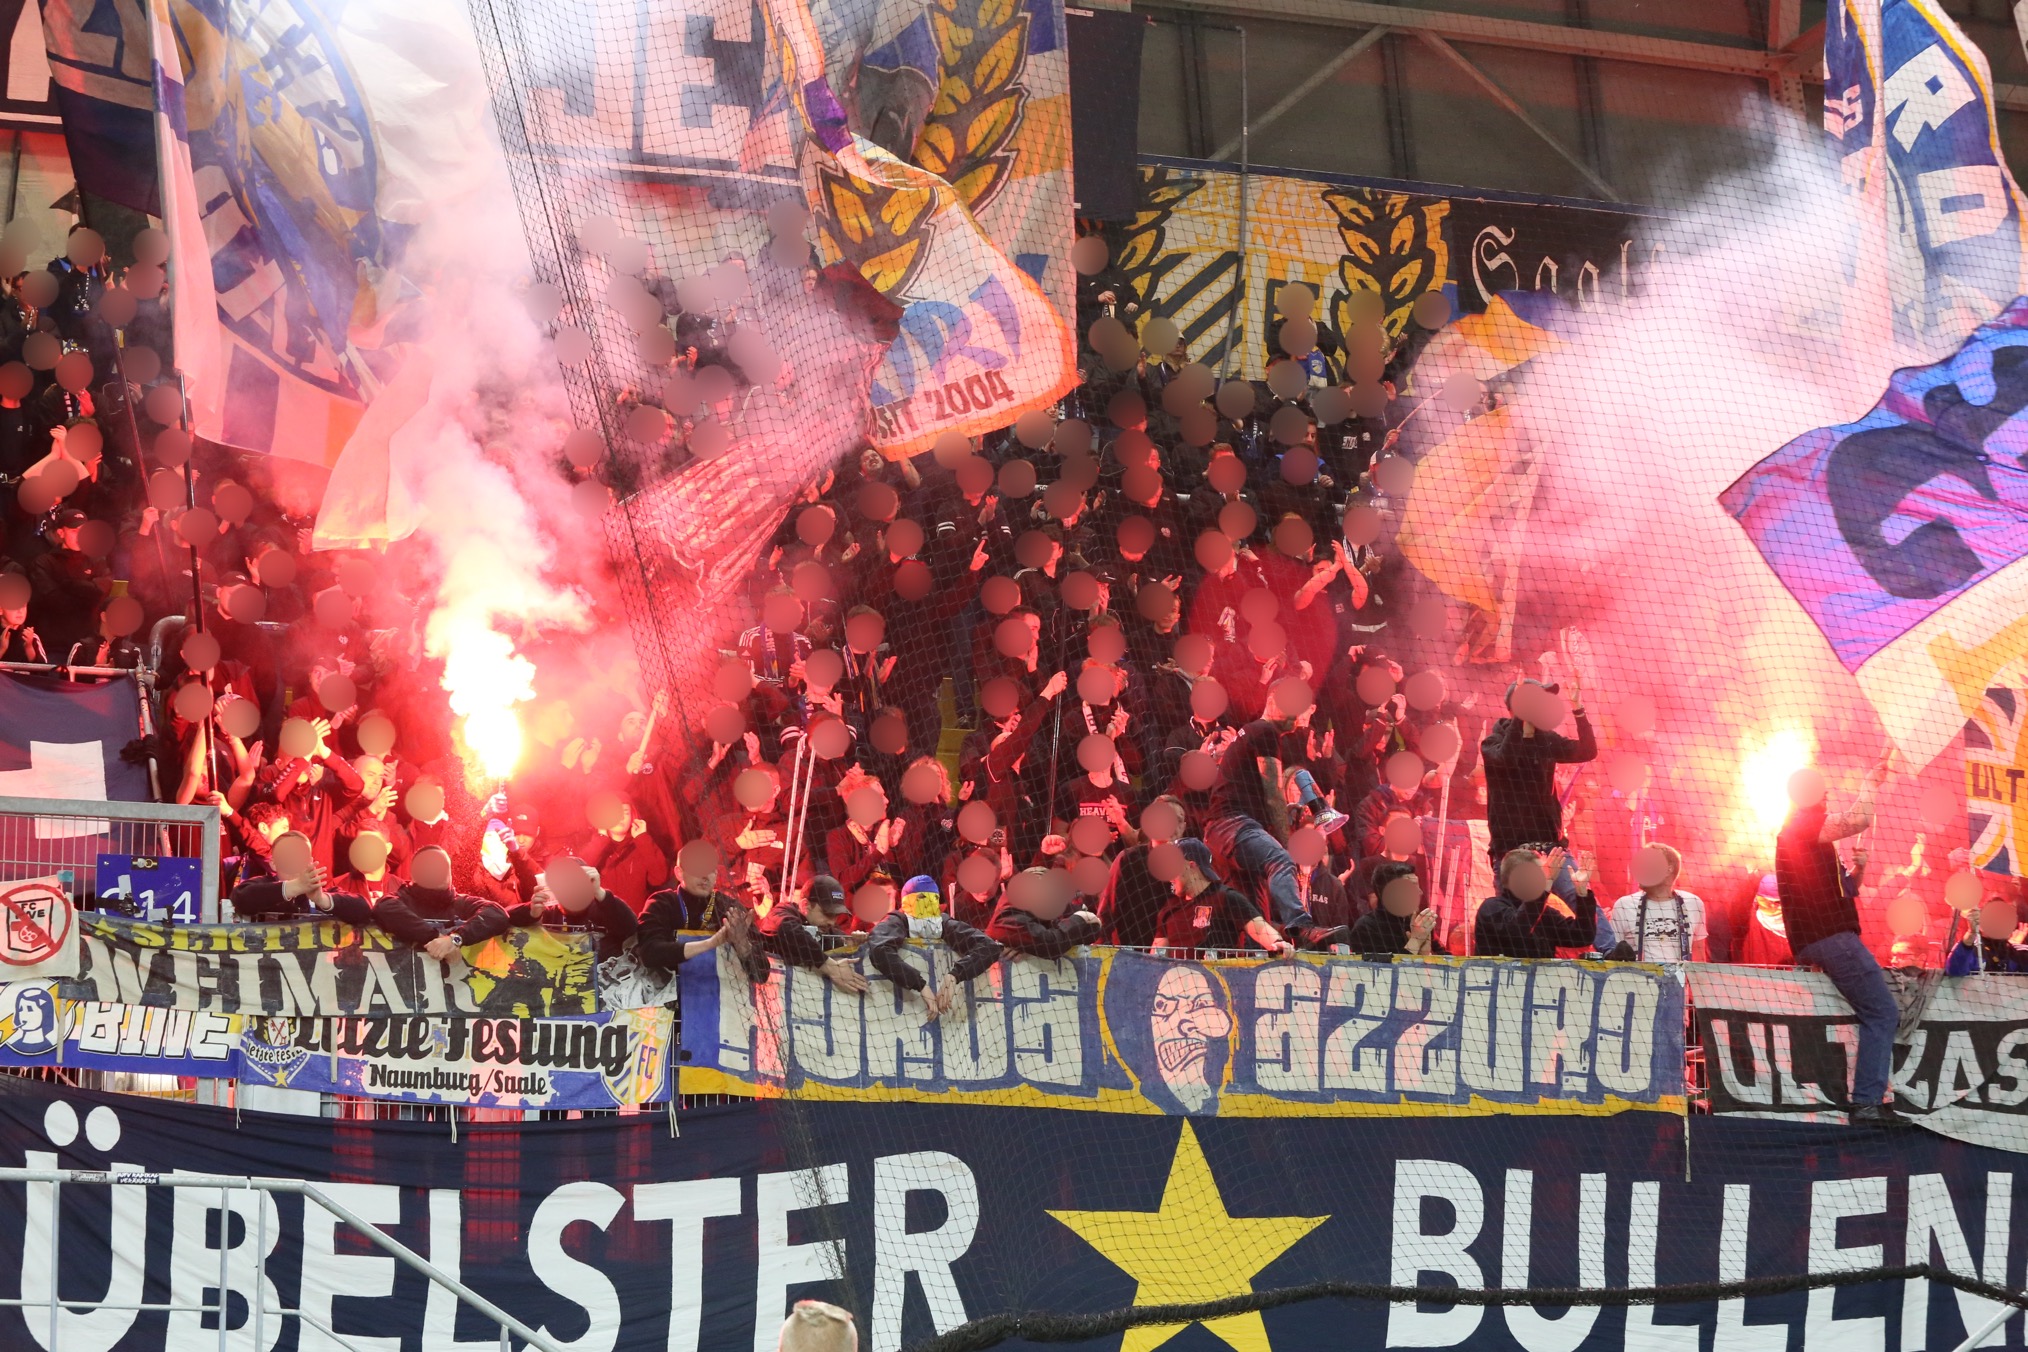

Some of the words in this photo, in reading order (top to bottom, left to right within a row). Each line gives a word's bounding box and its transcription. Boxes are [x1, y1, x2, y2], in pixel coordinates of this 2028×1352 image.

[1195, 218, 1304, 254] JENA
[923, 369, 1015, 422] 2004
[1079, 806, 1112, 817] HEAV
[132, 918, 396, 952] SEKTION
[82, 936, 482, 1017] WEIMAR
[78, 1000, 230, 1060] BINE
[637, 1044, 658, 1080] FC
[20, 1099, 980, 1352] ÜBELSTER
[1384, 1158, 2028, 1352] BULLEN
